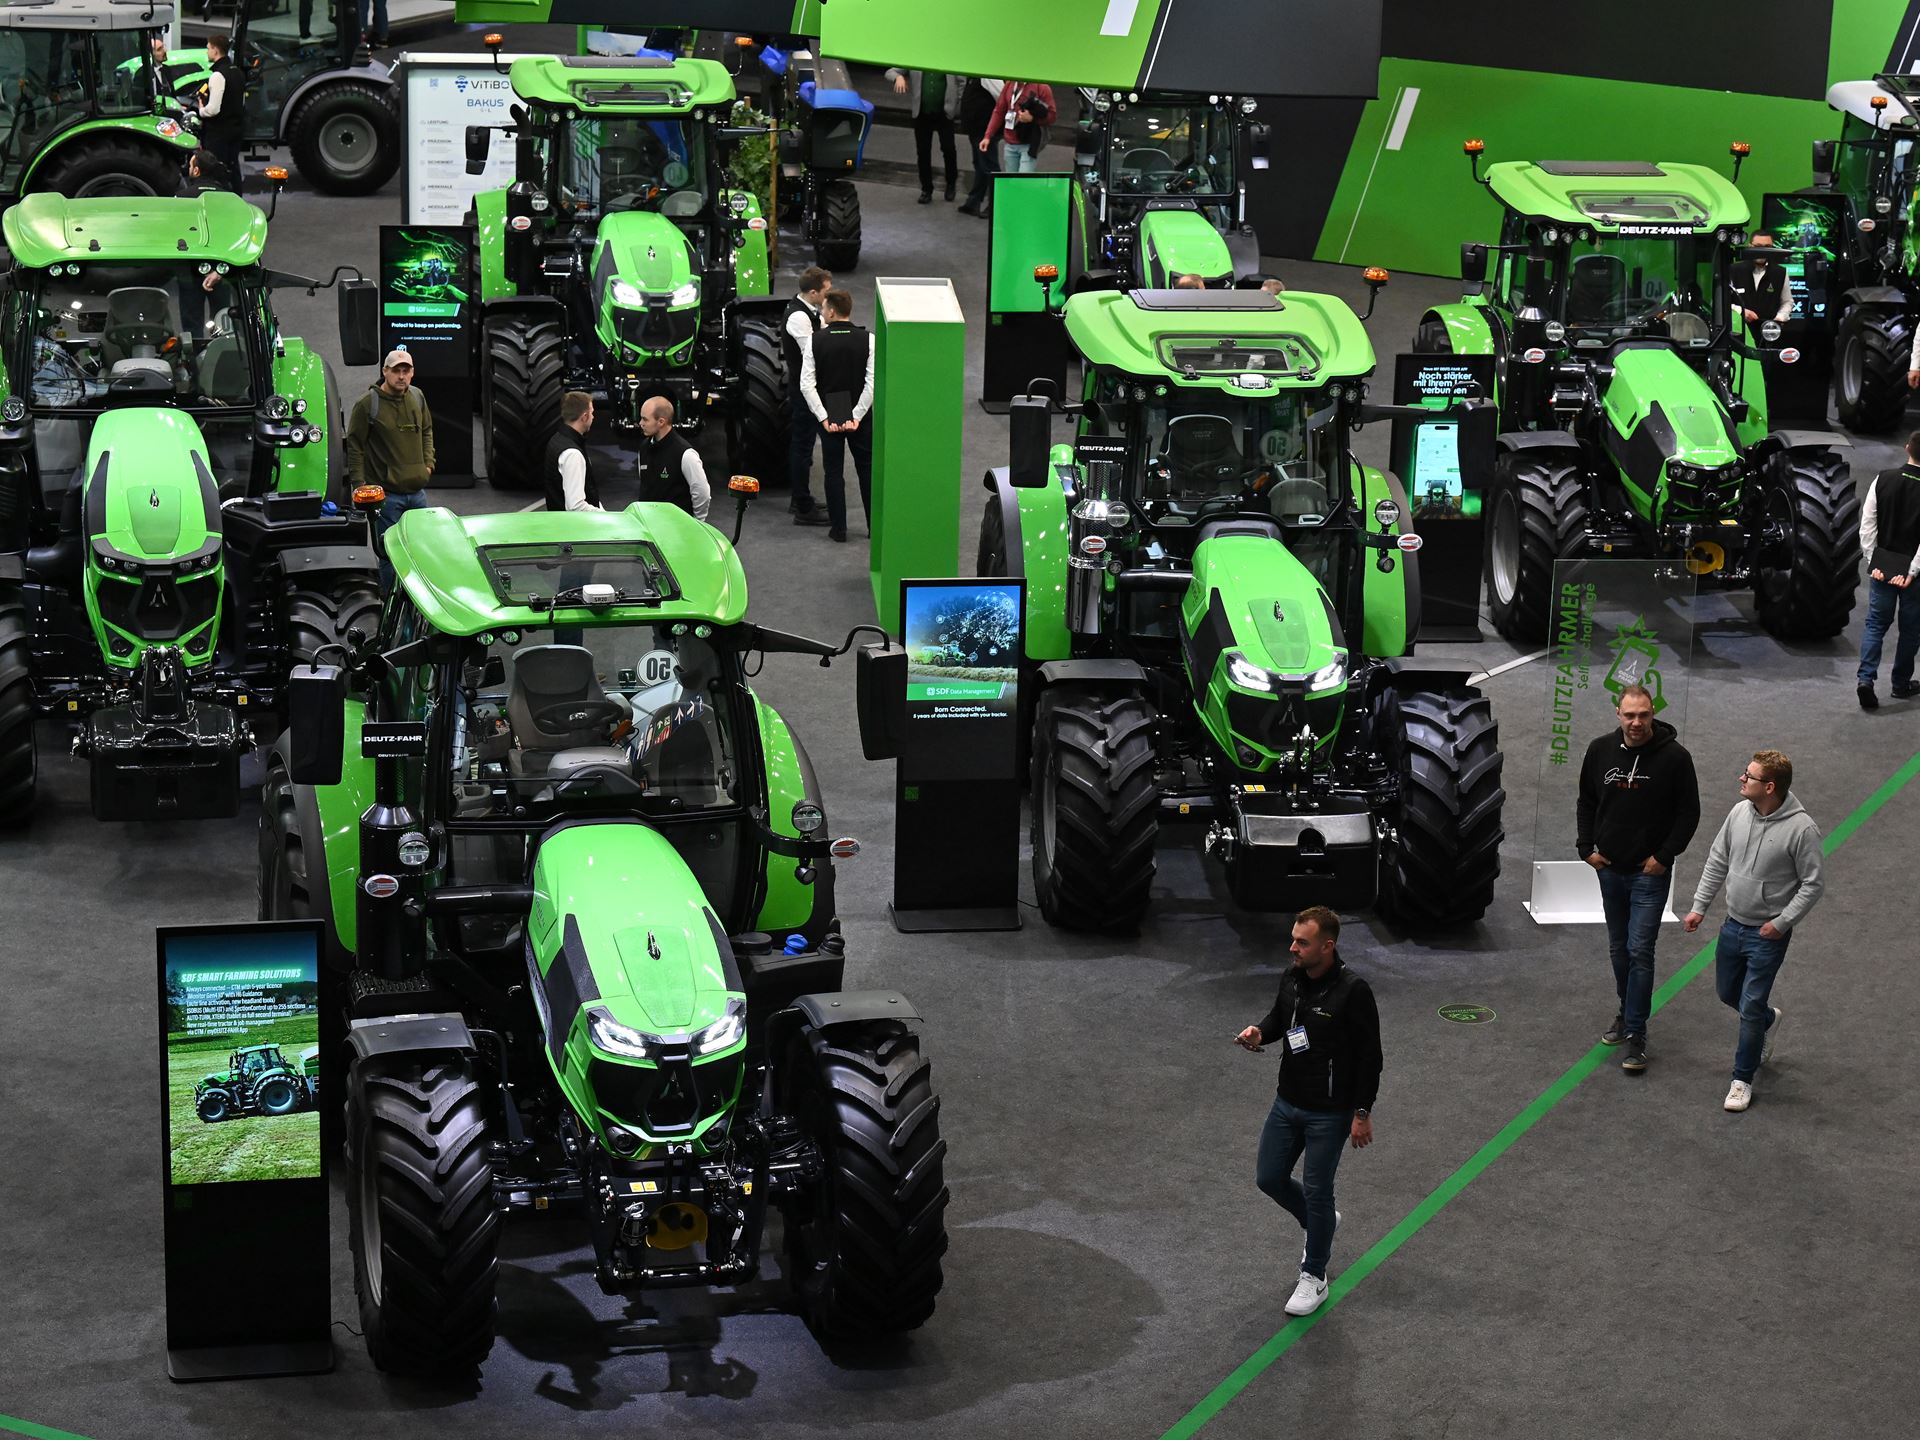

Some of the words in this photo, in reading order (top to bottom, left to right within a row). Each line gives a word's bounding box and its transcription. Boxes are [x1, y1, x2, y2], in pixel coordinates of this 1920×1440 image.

[471, 80, 510, 89] ViTiBO
[467, 99, 504, 107] BAKUS
[1620, 226, 1692, 234] DEUTZ-FAHR
[1419, 371, 1441, 380] Noch
[1443, 371, 1472, 380] stärker
[1413, 379, 1427, 387] mit
[1428, 379, 1453, 387] Ihrem
[1421, 386, 1467, 394] verbunen
[1550, 583, 1581, 765] #DEUTZFAHRMER
[181, 973, 197, 982] SDF
[197, 972, 224, 982] SMART
[224, 970, 259, 980] FARMING
[260, 969, 302, 979] SOLUTIONS
[235, 1004, 266, 1012] SectionControl
